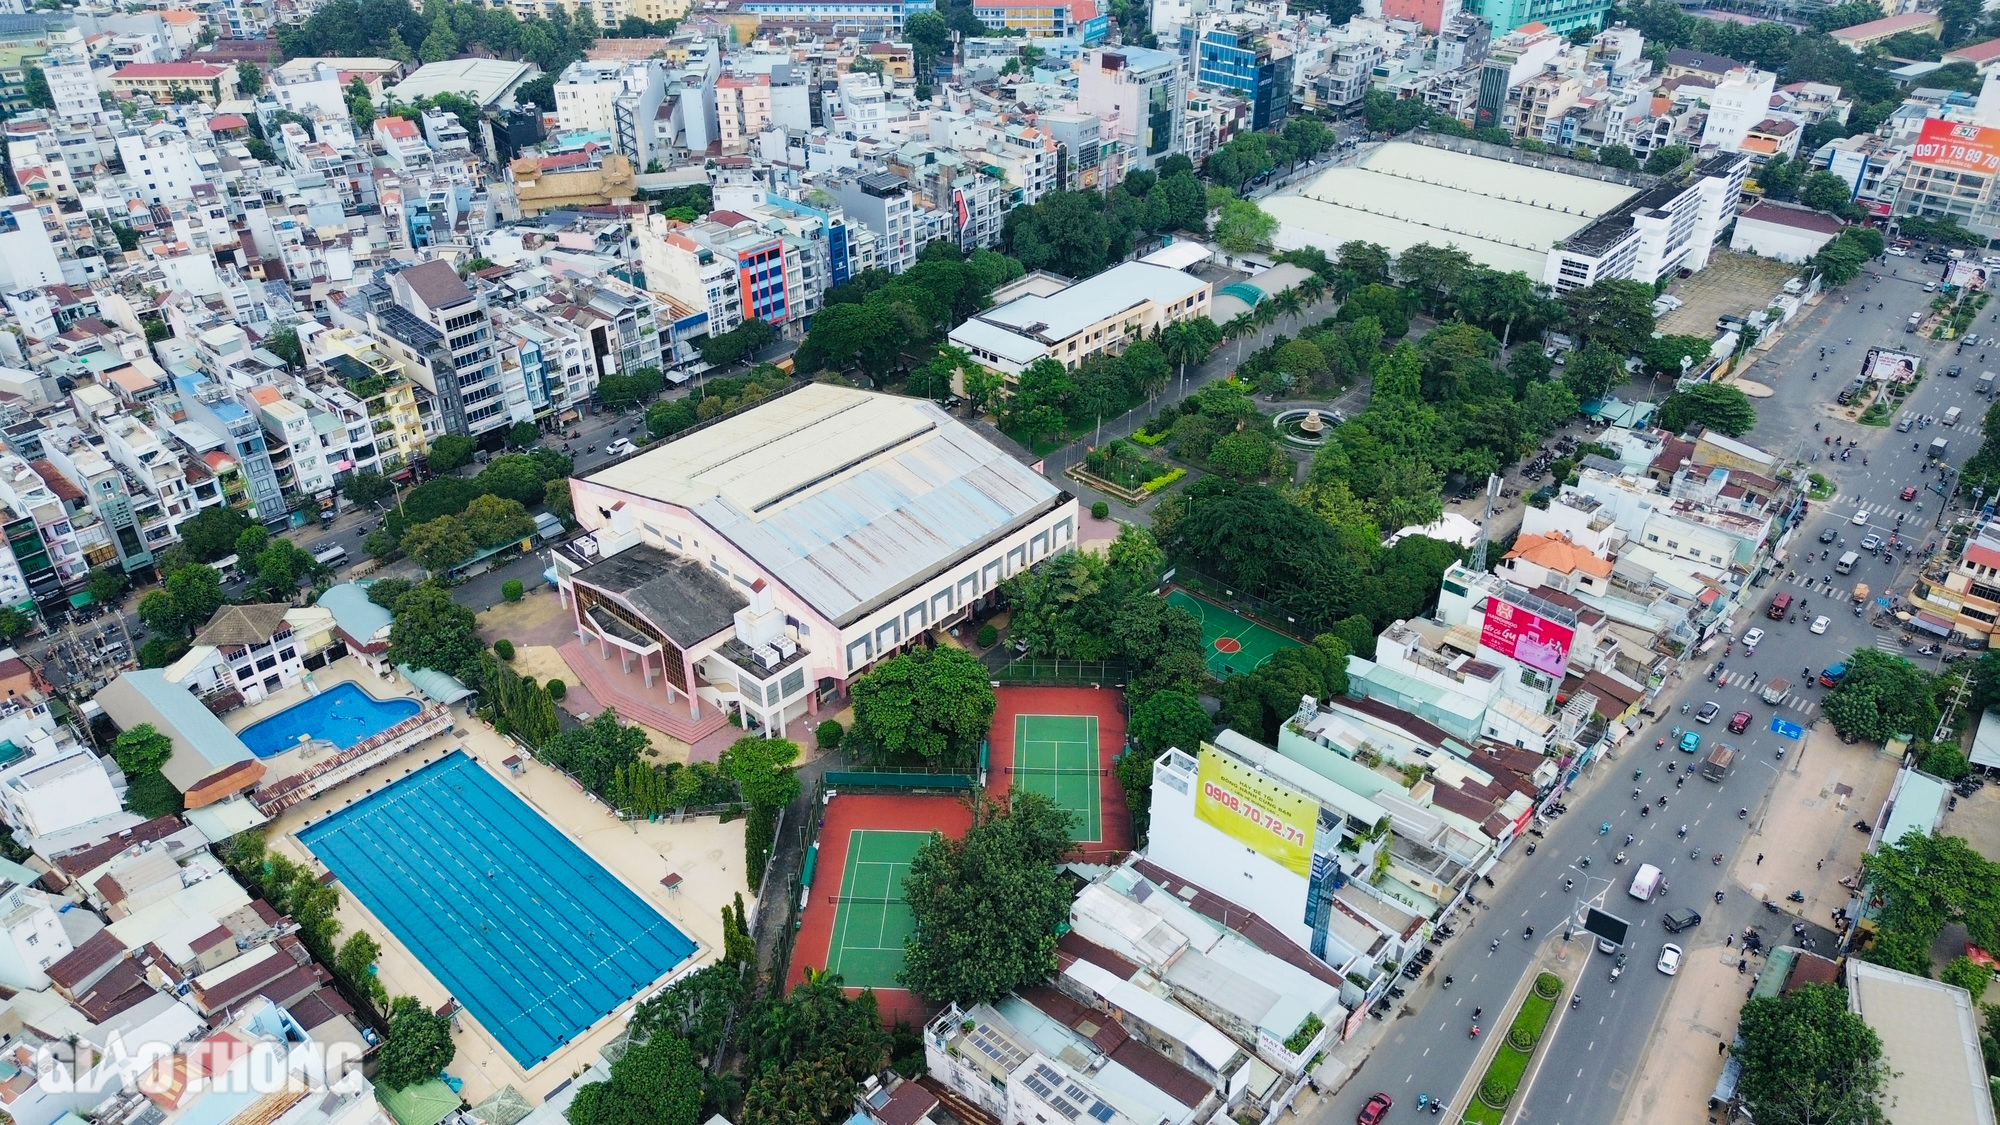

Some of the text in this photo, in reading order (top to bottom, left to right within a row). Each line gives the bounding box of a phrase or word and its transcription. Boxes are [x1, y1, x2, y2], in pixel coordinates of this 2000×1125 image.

[1917, 144, 2000, 169] 0971 79 89 79
[1205, 782, 1304, 847] 0908.70.72.71
